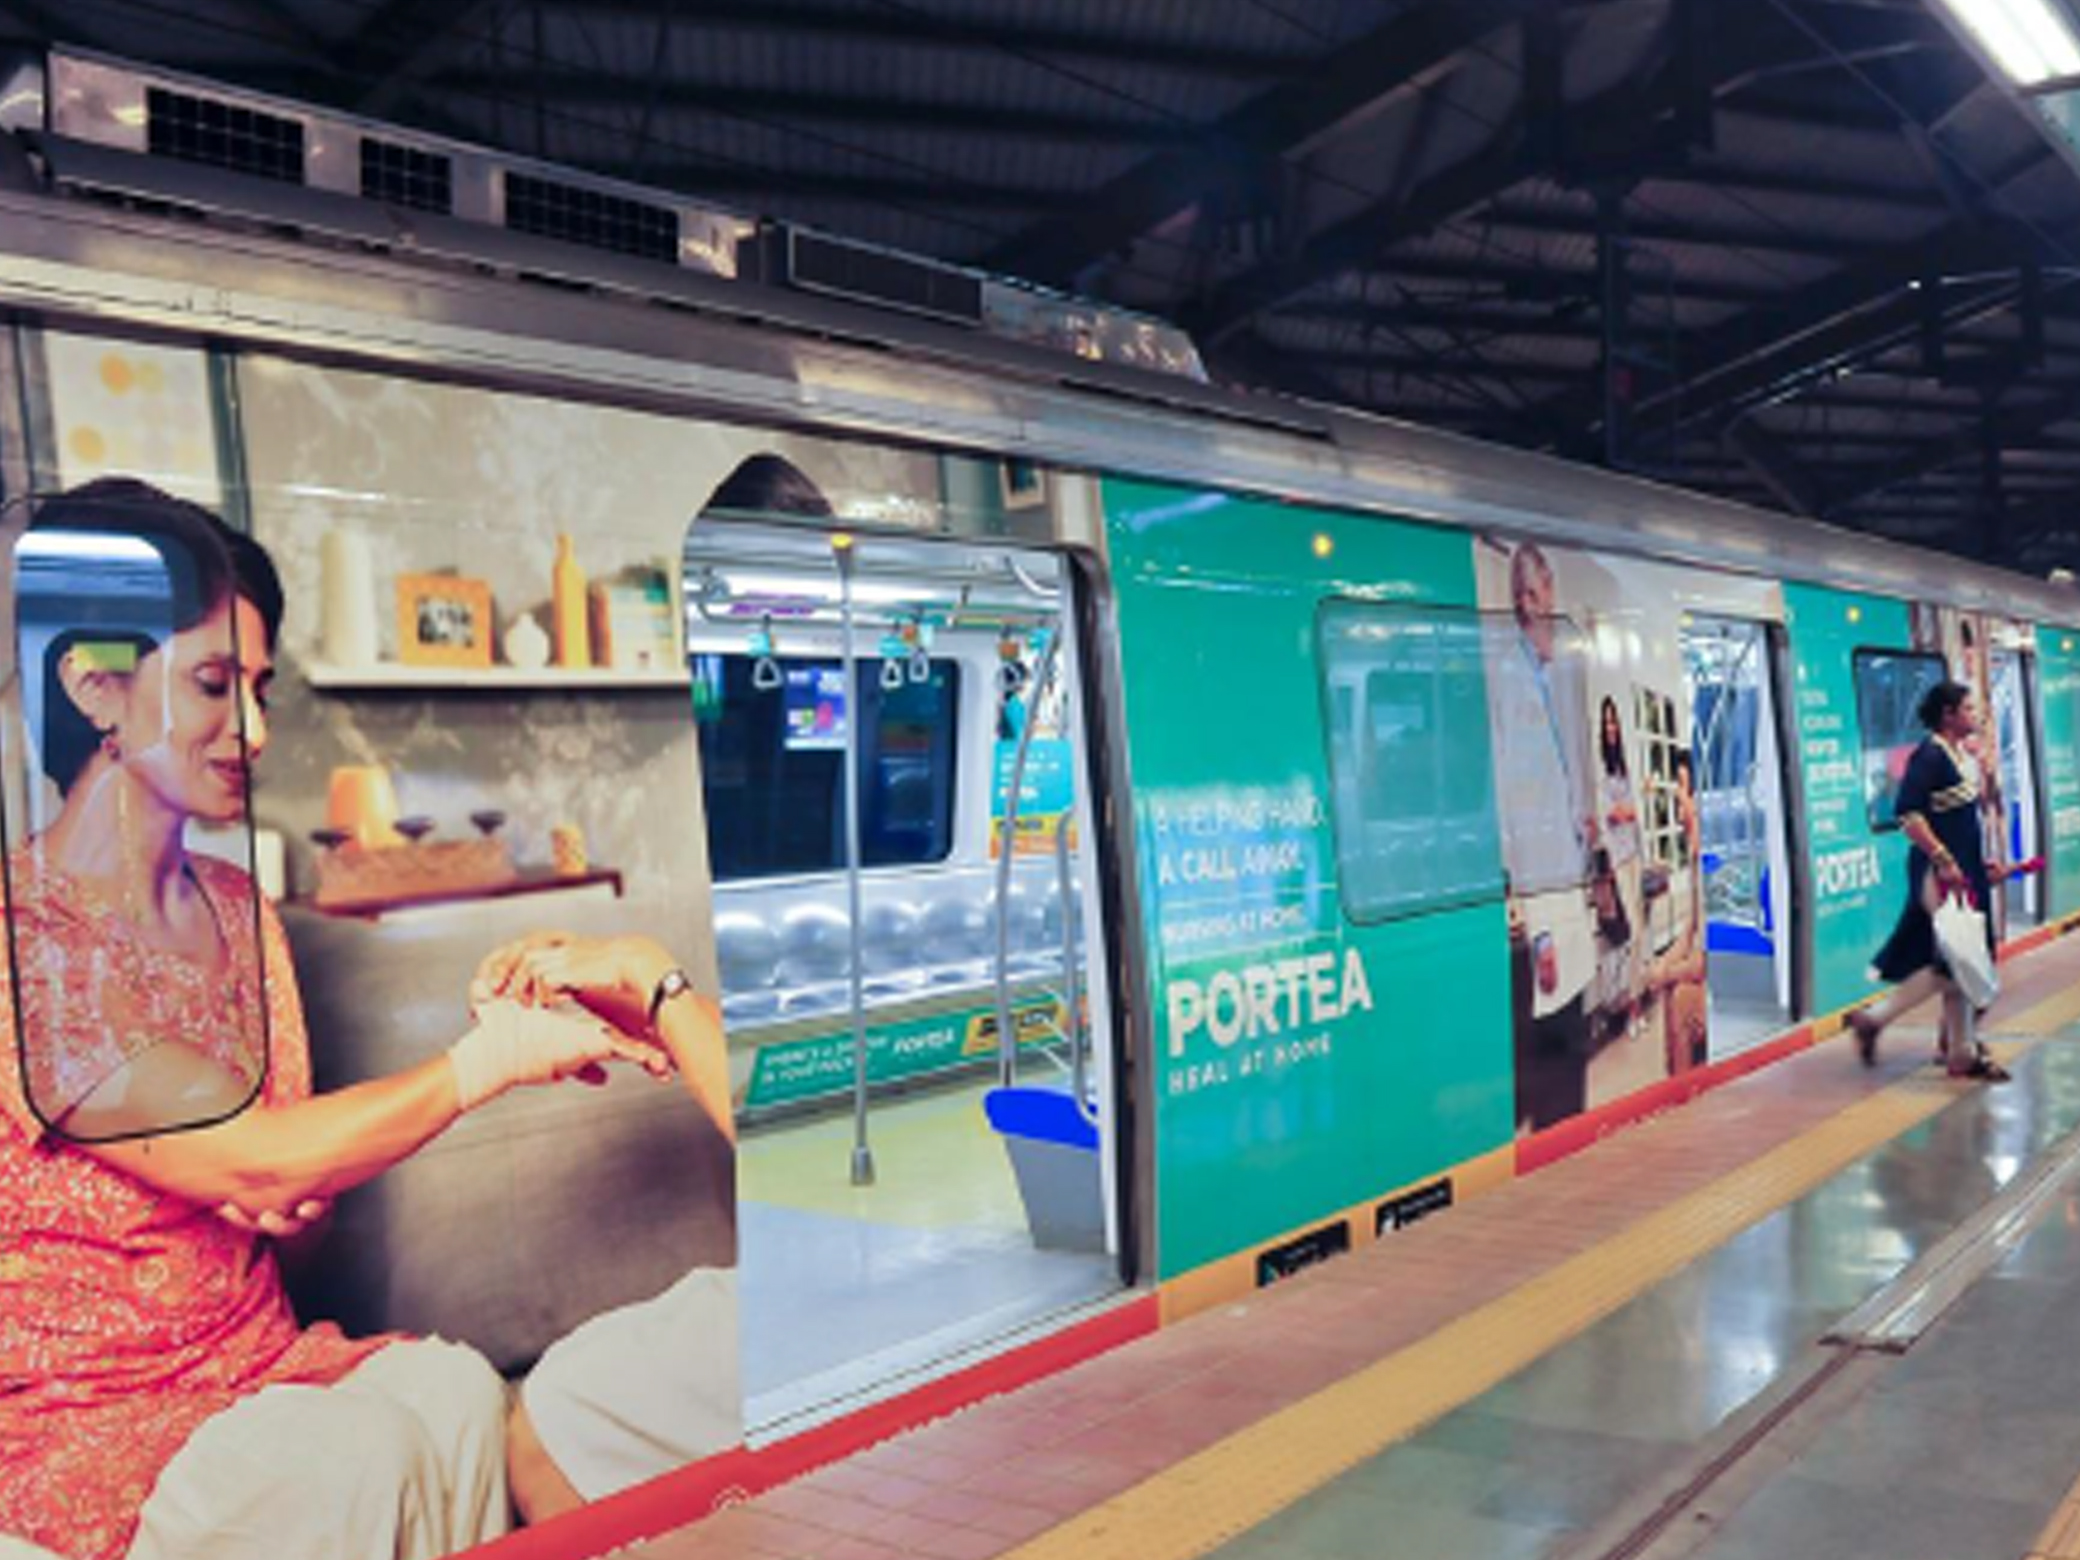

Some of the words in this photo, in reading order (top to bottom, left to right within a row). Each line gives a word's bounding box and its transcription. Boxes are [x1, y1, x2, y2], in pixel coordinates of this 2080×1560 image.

[1159, 852, 1177, 885] A
[1182, 846, 1237, 882] CALL
[1167, 947, 1373, 1057] PORTEA
[1168, 1061, 1228, 1095] HEAL
[1239, 1049, 1263, 1077] AT
